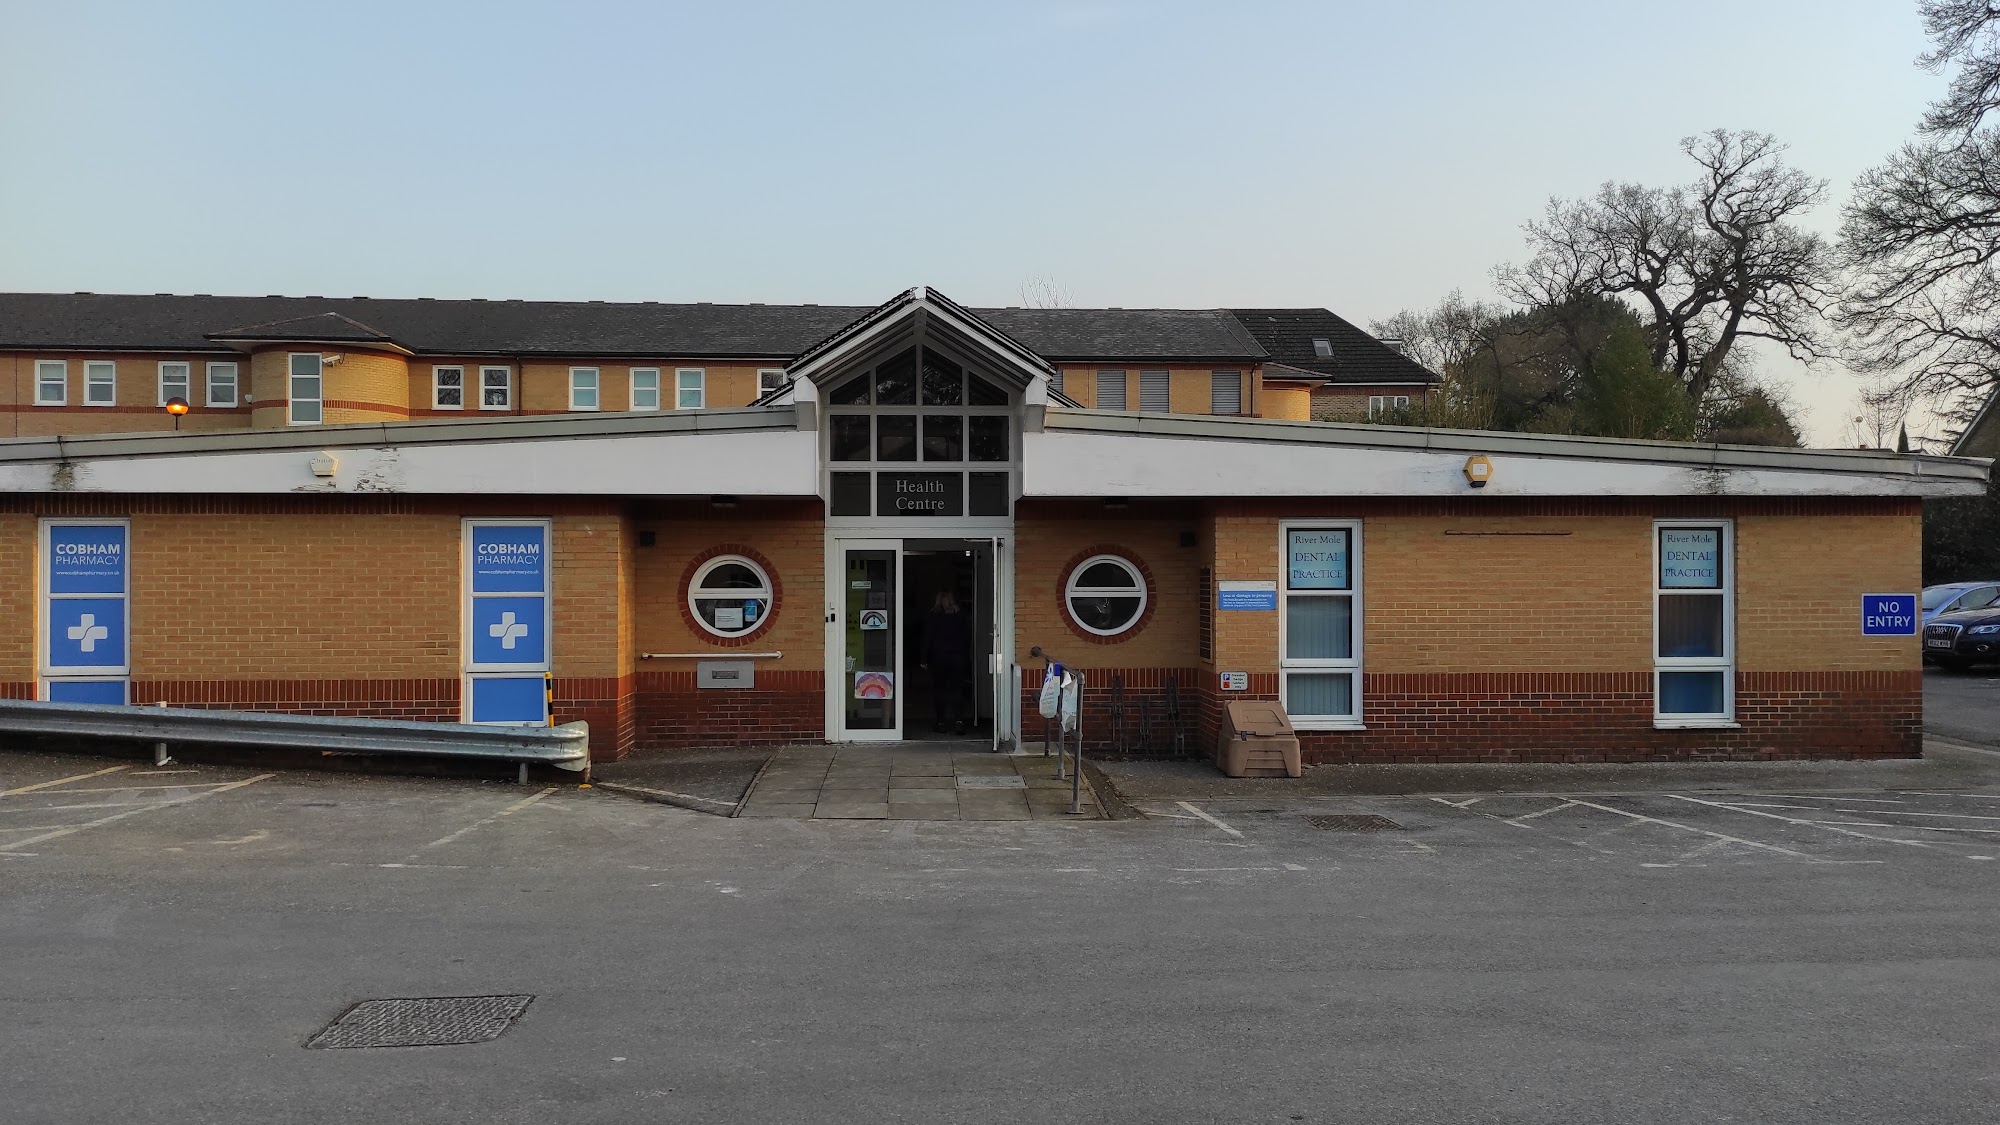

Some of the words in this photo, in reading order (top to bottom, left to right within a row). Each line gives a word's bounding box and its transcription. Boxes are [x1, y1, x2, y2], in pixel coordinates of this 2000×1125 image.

[895, 479, 944, 493] Health
[895, 496, 945, 510] Centre
[1295, 535, 1317, 544] River
[1319, 535, 1341, 544] Mole
[1667, 534, 1689, 543] River
[1691, 534, 1713, 543] Mole
[56, 543, 121, 555] COBHAM
[478, 543, 540, 554] COBHAM
[55, 555, 120, 565] PHARMACY
[477, 555, 539, 565] PHARMACY
[1295, 552, 1341, 562] DENTAL
[1667, 551, 1712, 561] DENTAL
[1293, 569, 1342, 579] PRACTICE
[1665, 568, 1714, 578] PRACTICE
[1878, 601, 1900, 613] NO
[1867, 615, 1911, 627] ENTRY
